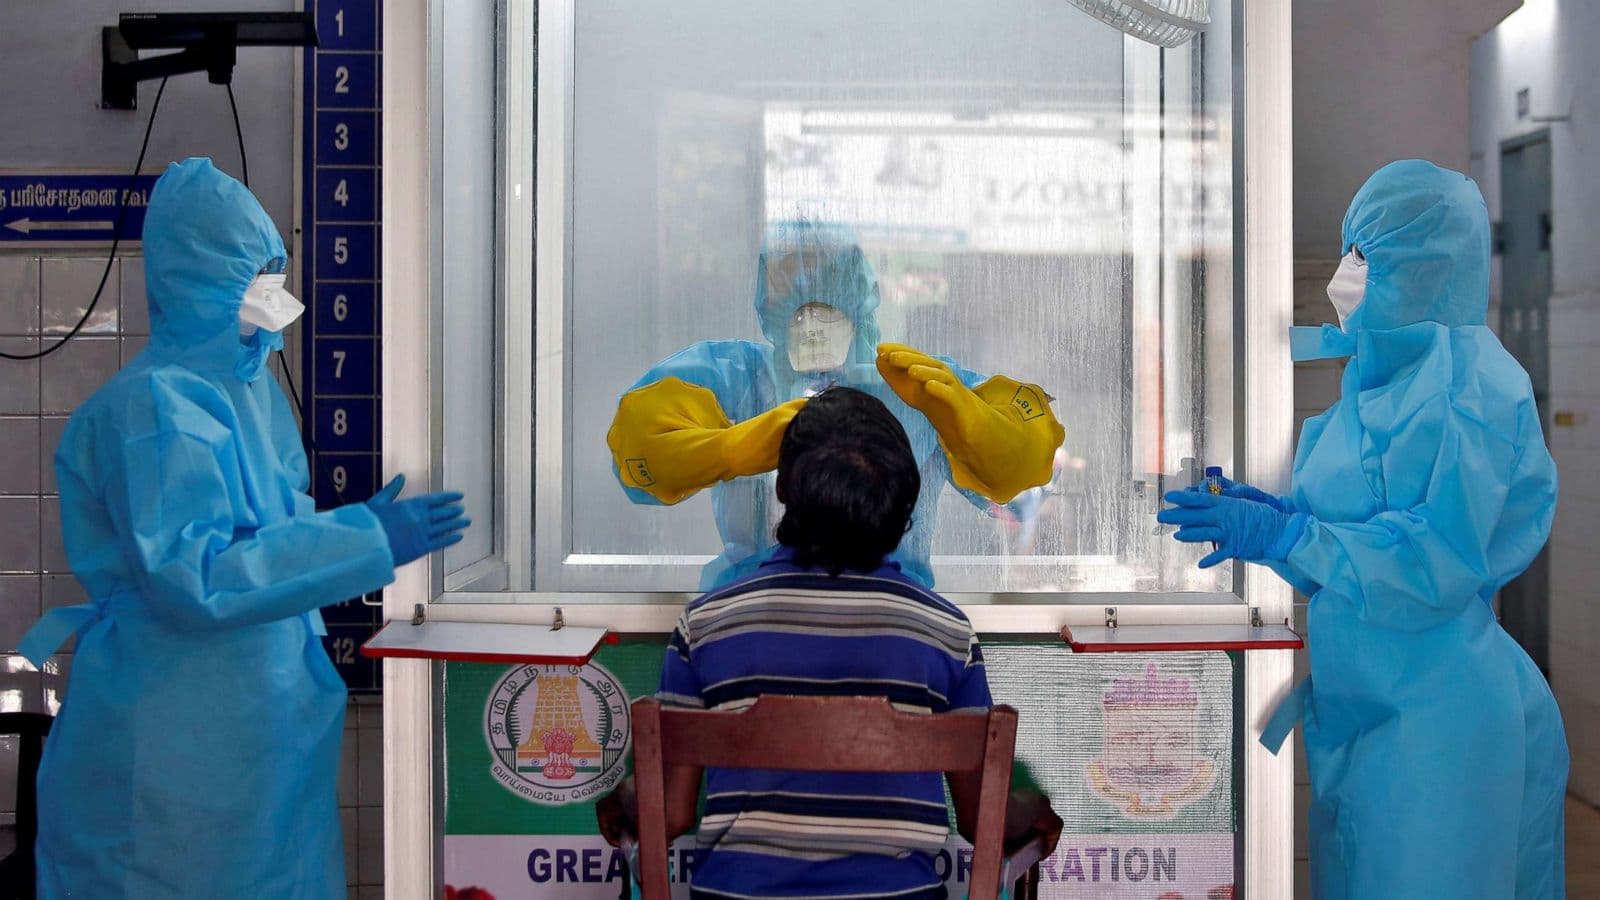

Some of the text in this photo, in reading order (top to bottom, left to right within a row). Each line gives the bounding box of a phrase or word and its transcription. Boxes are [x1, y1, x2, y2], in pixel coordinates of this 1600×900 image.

[335, 10, 344, 37] 1
[335, 66, 350, 93] 2
[335, 123, 349, 150] 3
[11, 184, 117, 213] பரிசோதனை
[334, 180, 349, 207] 4
[334, 237, 348, 264] 5
[334, 295, 348, 321] 6
[333, 352, 346, 378] 7
[333, 409, 348, 436] 8
[333, 466, 347, 492] 9
[333, 638, 355, 664] 12
[527, 848, 697, 883] GREAR
